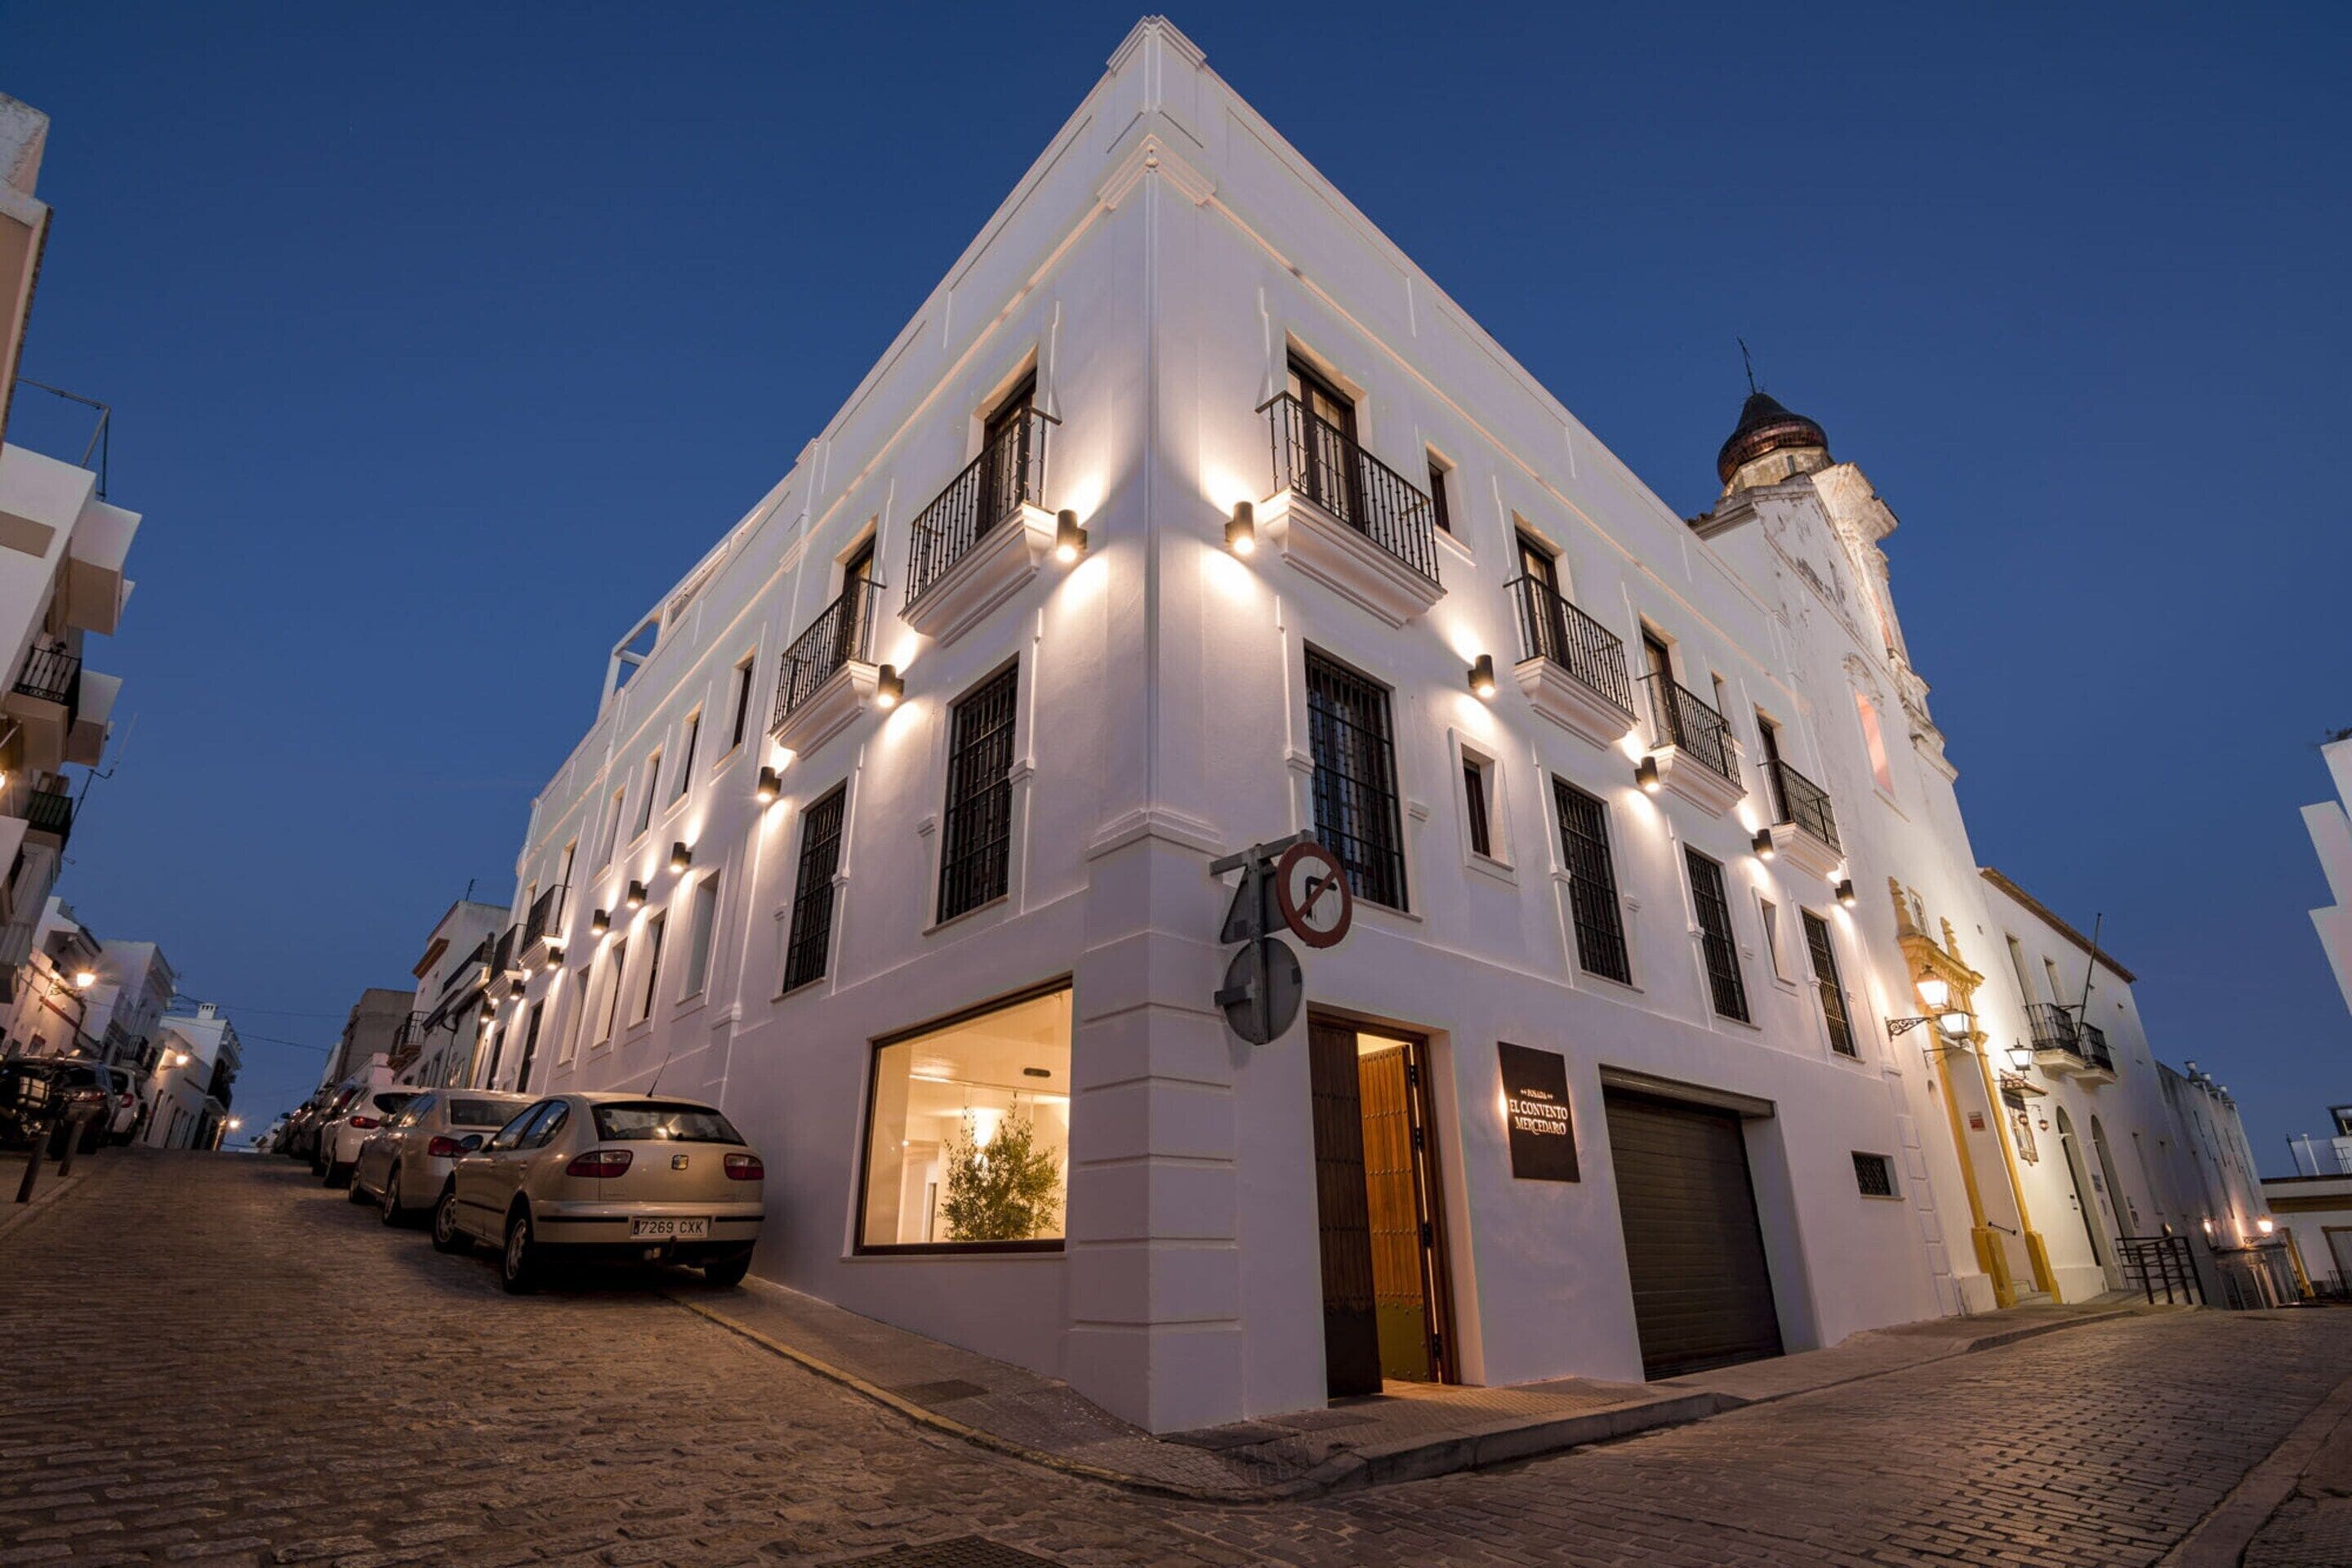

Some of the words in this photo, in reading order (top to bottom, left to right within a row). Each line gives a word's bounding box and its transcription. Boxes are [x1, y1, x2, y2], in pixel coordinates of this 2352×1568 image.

[1509, 1099, 1520, 1113] EL
[1521, 1100, 1568, 1120] CONVENTO
[1515, 1116, 1566, 1135] MERCEDARIO
[641, 1221, 674, 1233] 7269
[679, 1221, 703, 1233] CXK
